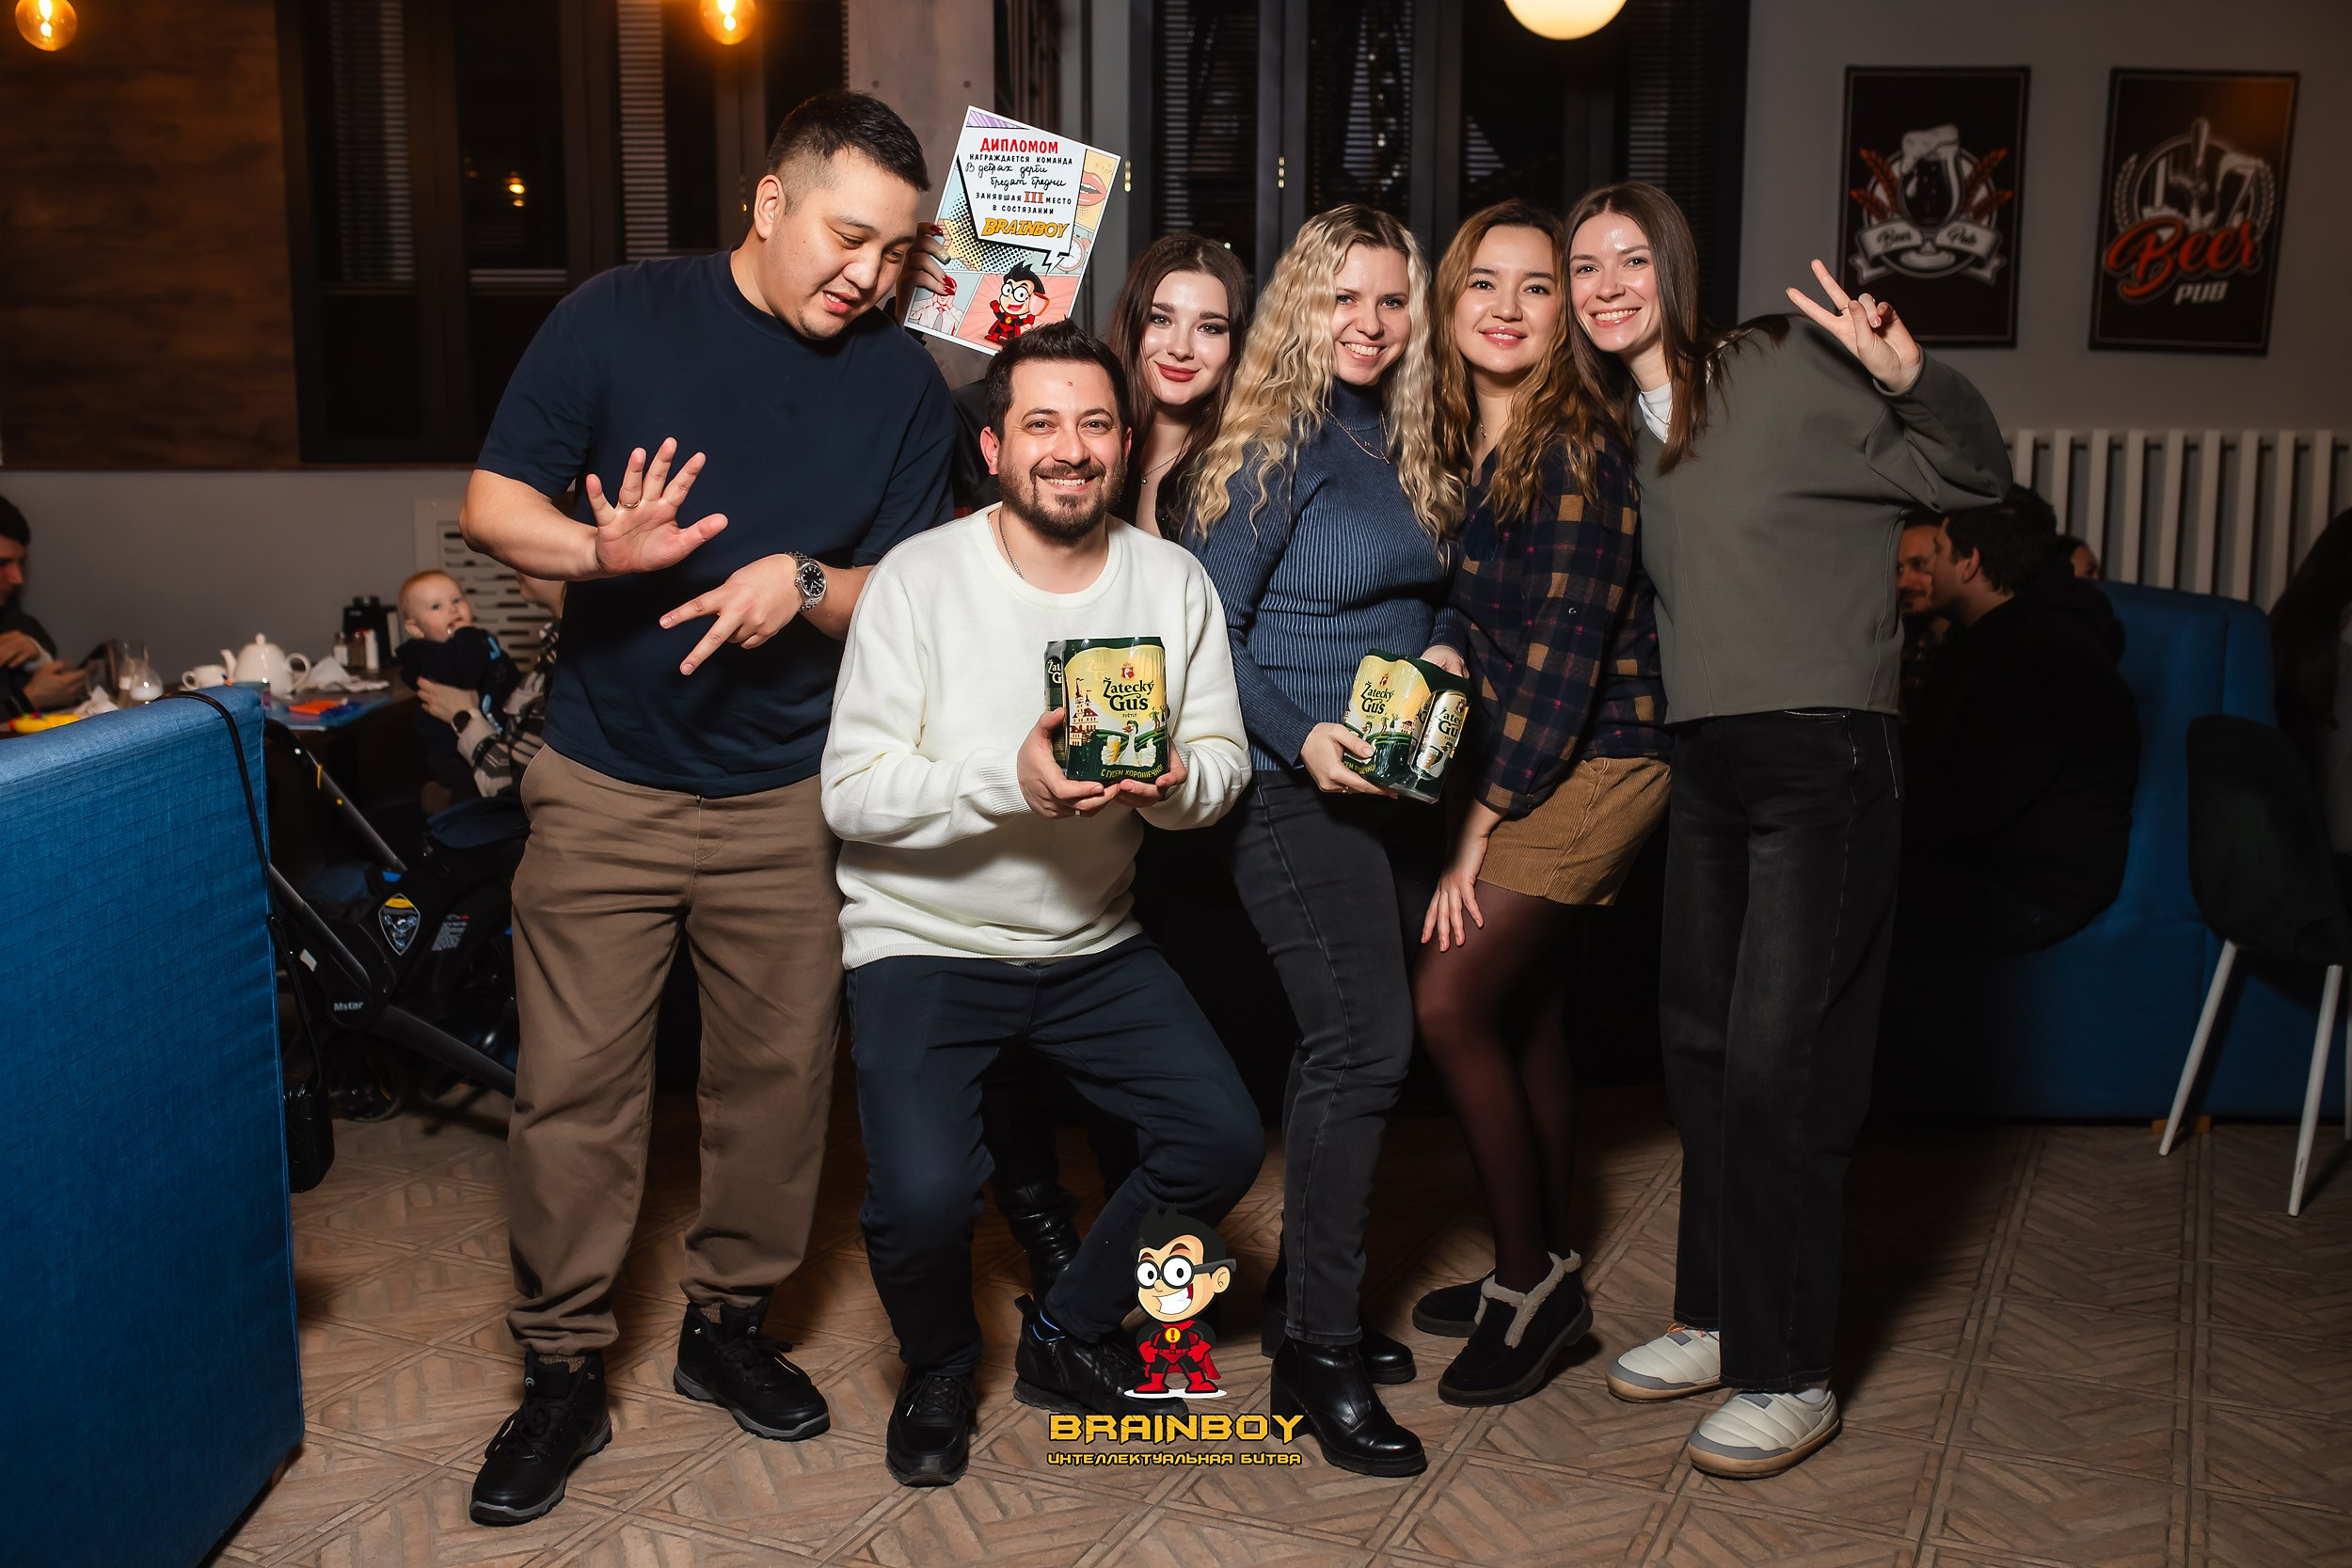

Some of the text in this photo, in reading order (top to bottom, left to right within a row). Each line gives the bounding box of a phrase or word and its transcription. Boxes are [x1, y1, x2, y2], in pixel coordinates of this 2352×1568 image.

[979, 137, 1058, 154] ДИПЛОМОМ
[965, 162, 976, 172] В
[969, 153, 1073, 165] НАГРАЖДАЕТСЯ КОМАНДА
[975, 191, 1072, 205] ЗАНЯВШАЯ III МЕСТО
[1001, 205, 1055, 214] СОСТЯЗАНИИ
[981, 217, 1070, 238] BRAINBOY
[2106, 216, 2255, 297] Beer
[2173, 281, 2229, 306] PUB
[1102, 676, 1155, 699] Žatecký
[1360, 681, 1395, 703] Žatecký
[1100, 768, 1106, 777] С
[1105, 769, 1124, 779] ГУСЕМ
